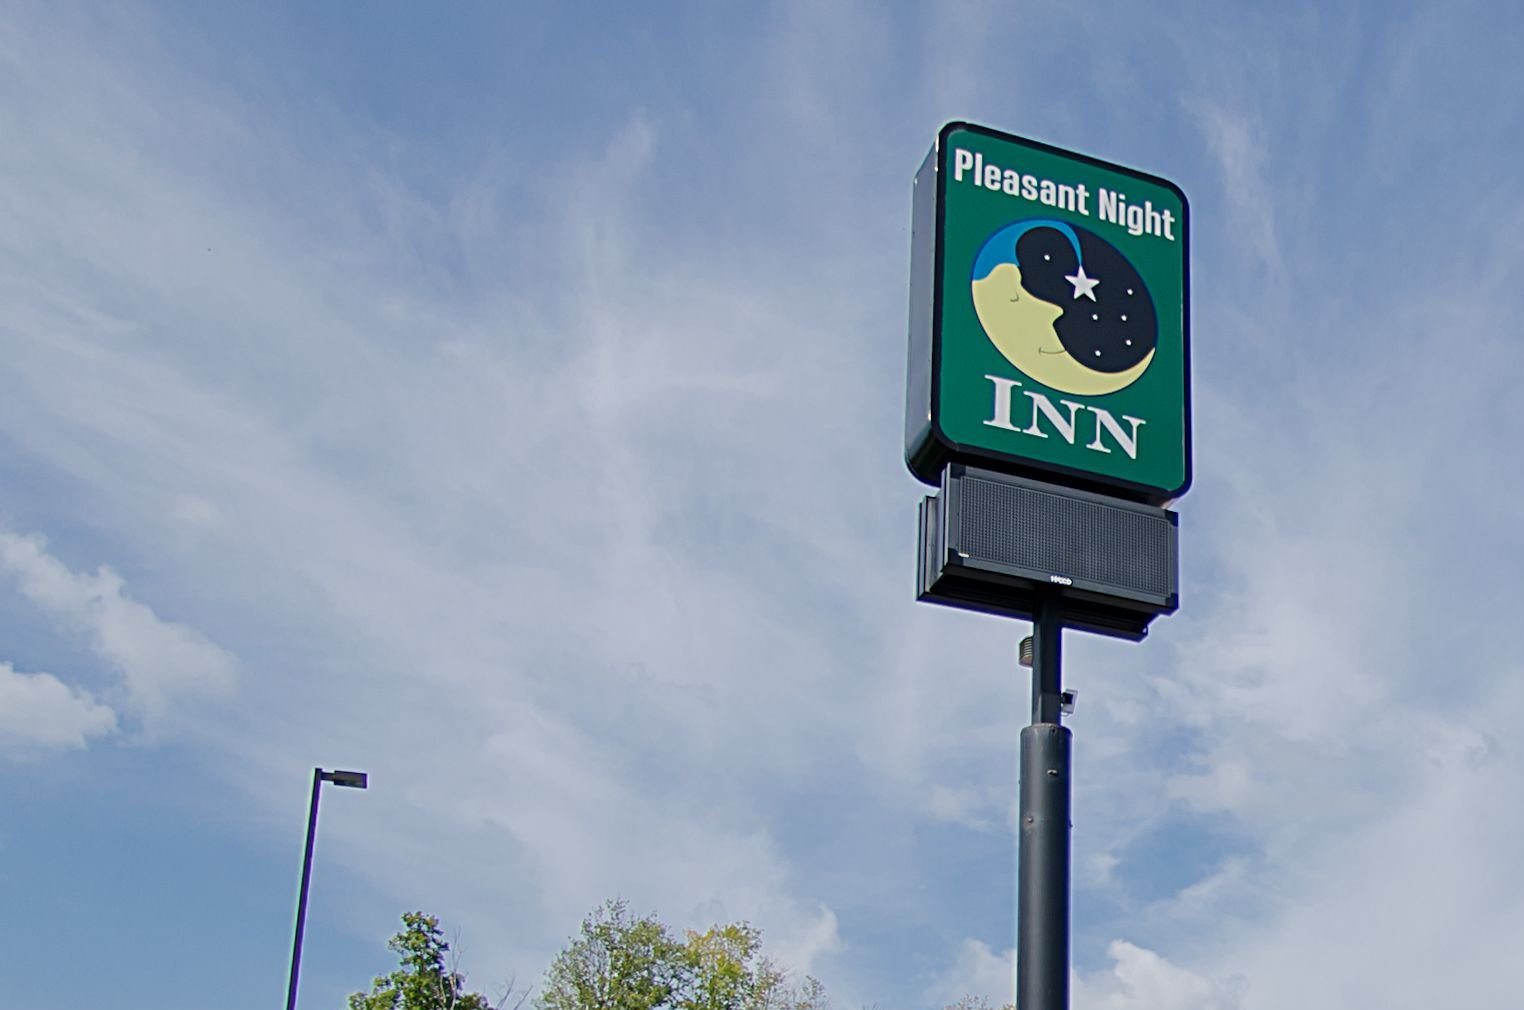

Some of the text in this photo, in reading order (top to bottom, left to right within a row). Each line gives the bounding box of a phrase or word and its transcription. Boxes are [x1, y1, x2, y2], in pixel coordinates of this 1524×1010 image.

[954, 148, 1175, 241] Pleasant Night
[983, 374, 1146, 460] INN
